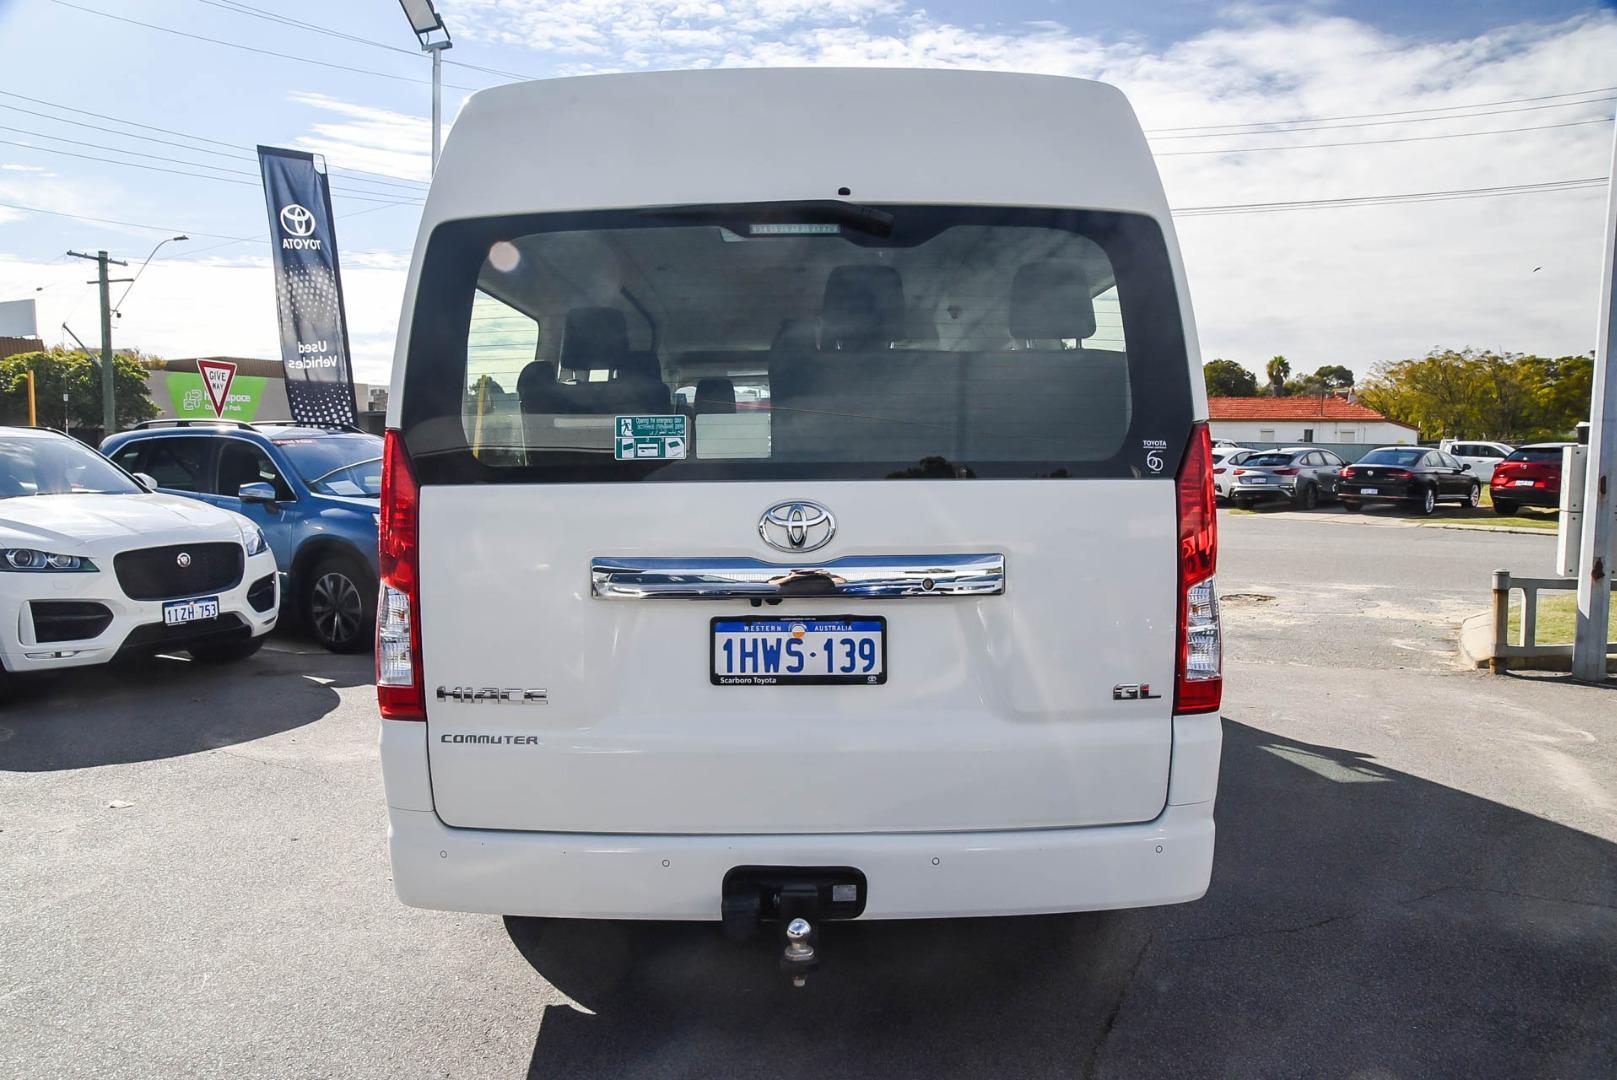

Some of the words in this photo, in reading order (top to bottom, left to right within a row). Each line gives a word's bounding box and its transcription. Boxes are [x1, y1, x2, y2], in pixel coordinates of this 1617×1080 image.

[209, 371, 226, 381] GIVE
[212, 382, 223, 390] WAY
[753, 677, 776, 685] Toyota
[436, 686, 549, 705] HIACE
[1112, 683, 1161, 701] GL
[441, 734, 538, 745] COMMUTER
